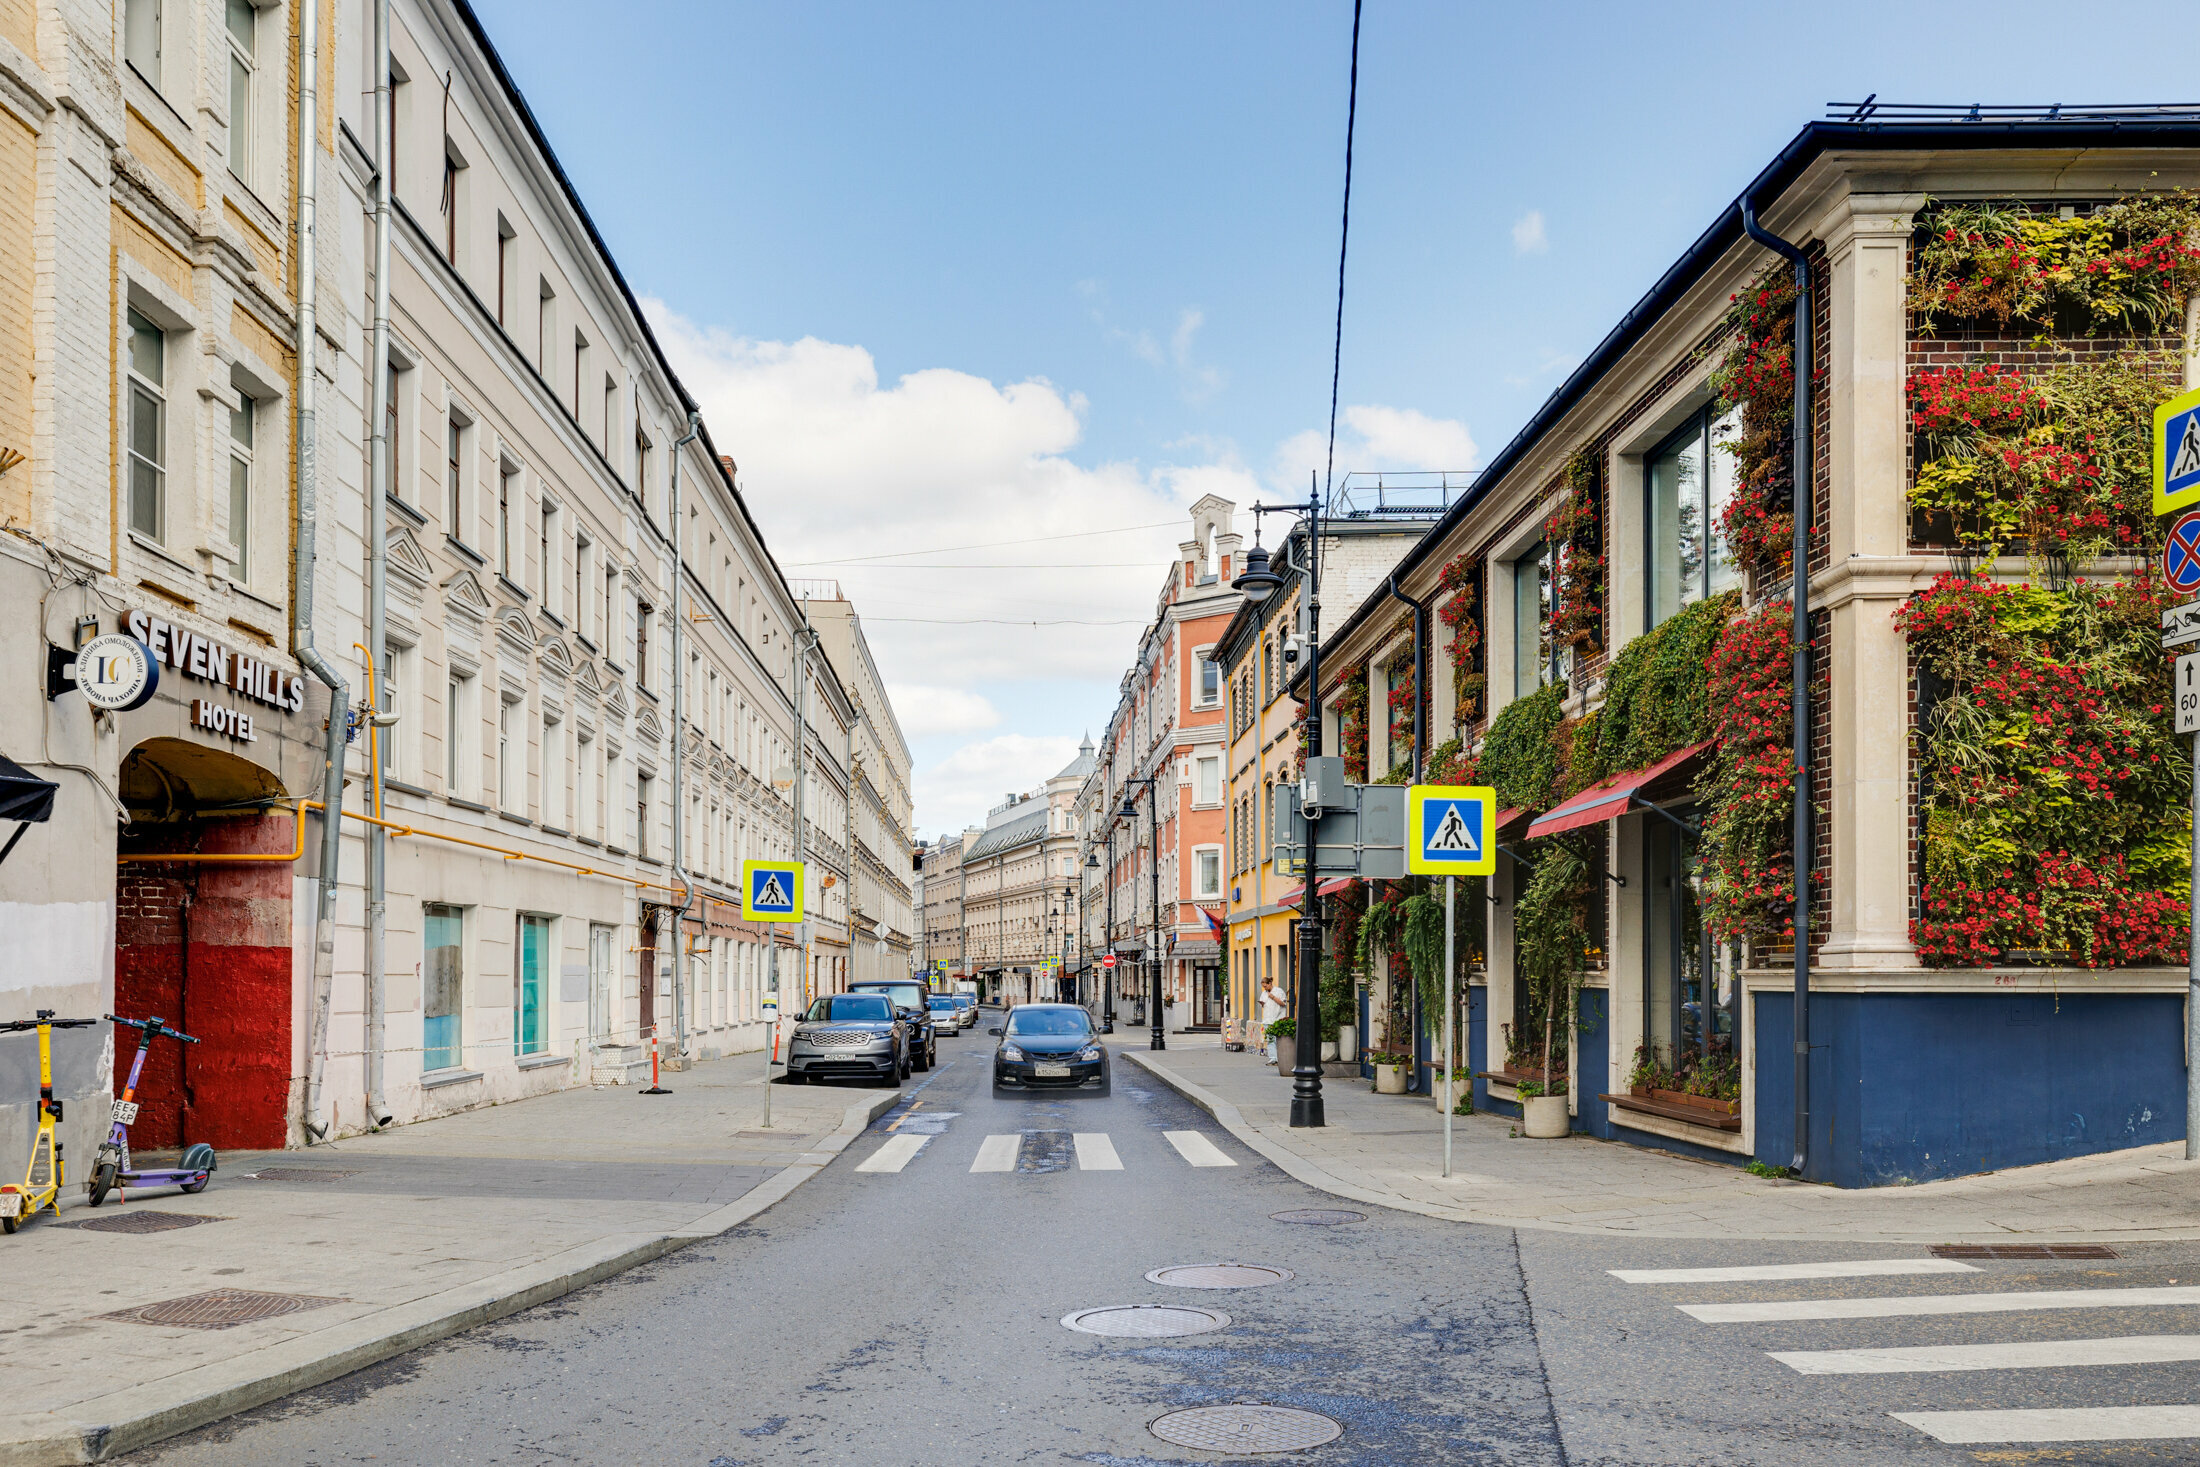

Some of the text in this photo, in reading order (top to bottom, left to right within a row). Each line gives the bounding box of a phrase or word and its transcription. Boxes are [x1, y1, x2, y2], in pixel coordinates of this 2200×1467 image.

[79, 637, 143, 674] КЛИНИКА ОМОЛОЖЕНИЯ
[129, 610, 304, 713] SEVEN HILLS
[80, 677, 141, 704] ЛЕВОНА ЧАХОЯНА
[2181, 692, 2198, 711] 60
[200, 700, 258, 742] HOTEL
